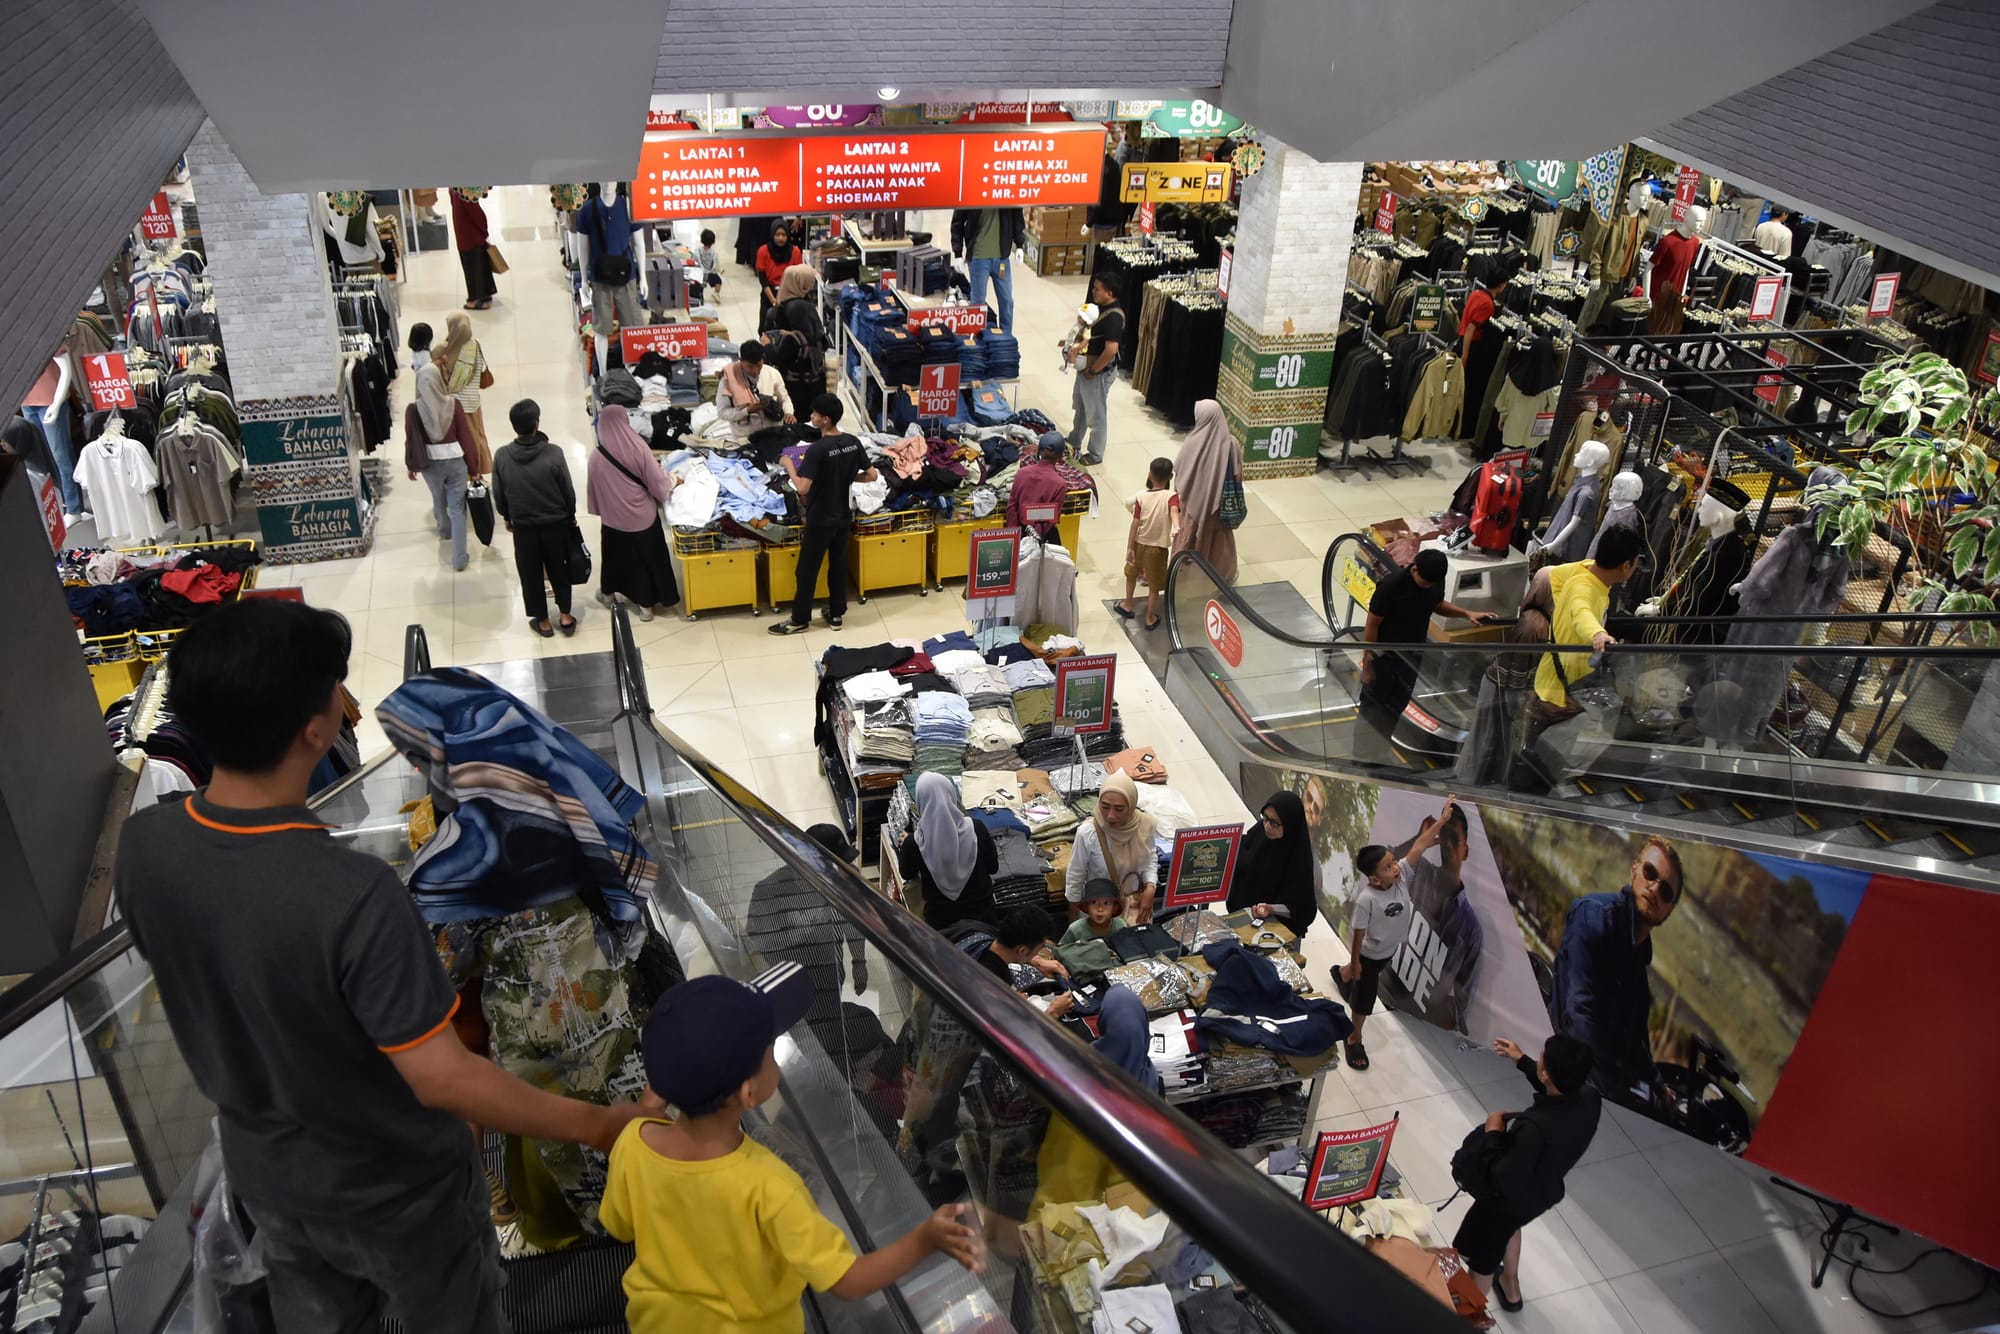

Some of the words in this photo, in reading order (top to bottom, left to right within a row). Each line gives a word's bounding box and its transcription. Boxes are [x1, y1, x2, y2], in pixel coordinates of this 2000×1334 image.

[844, 142, 896, 156] LANTAI
[900, 142, 909, 154] 2
[994, 139, 1042, 152] LANTAI
[1046, 139, 1054, 151] 3
[680, 147, 732, 160] LANTAI
[738, 147, 745, 158] 1
[826, 163, 885, 175] PAKAIAN
[889, 162, 941, 174] WANITA
[993, 160, 1043, 171] CINEMA
[1047, 159, 1068, 170] XXI
[662, 168, 723, 181] PAKAIAN
[728, 167, 760, 178] PRIA
[993, 174, 1016, 185] THE
[1021, 173, 1051, 184] PLAY
[1054, 173, 1088, 183] ZONE
[662, 183, 736, 196] ROBINSON
[741, 181, 779, 193] MART
[826, 178, 885, 190] PAKAIAN
[889, 177, 925, 188] ANAK
[826, 192, 898, 204] SHOEMART
[992, 188, 1015, 199] MR.
[1019, 188, 1040, 198] DIY
[663, 197, 751, 211] RESTAURANT
[148, 222, 169, 234] 120
[935, 308, 968, 317] HARGA
[91, 355, 111, 378] 1
[88, 378, 129, 389] HARGA
[931, 366, 945, 388] 1
[97, 387, 126, 403] 130
[925, 398, 950, 411] 100
[278, 420, 343, 441] Lebaran
[284, 438, 345, 454] BAHAGIA
[286, 504, 349, 523] Lebaran
[291, 520, 352, 536] BAHAGIA
[1180, 830, 1209, 839] MURAH
[1210, 827, 1240, 835] BANGET
[1408, 900, 1448, 982] ON
[1322, 1133, 1358, 1142] MURAH
[1359, 1122, 1395, 1138] BANGET
